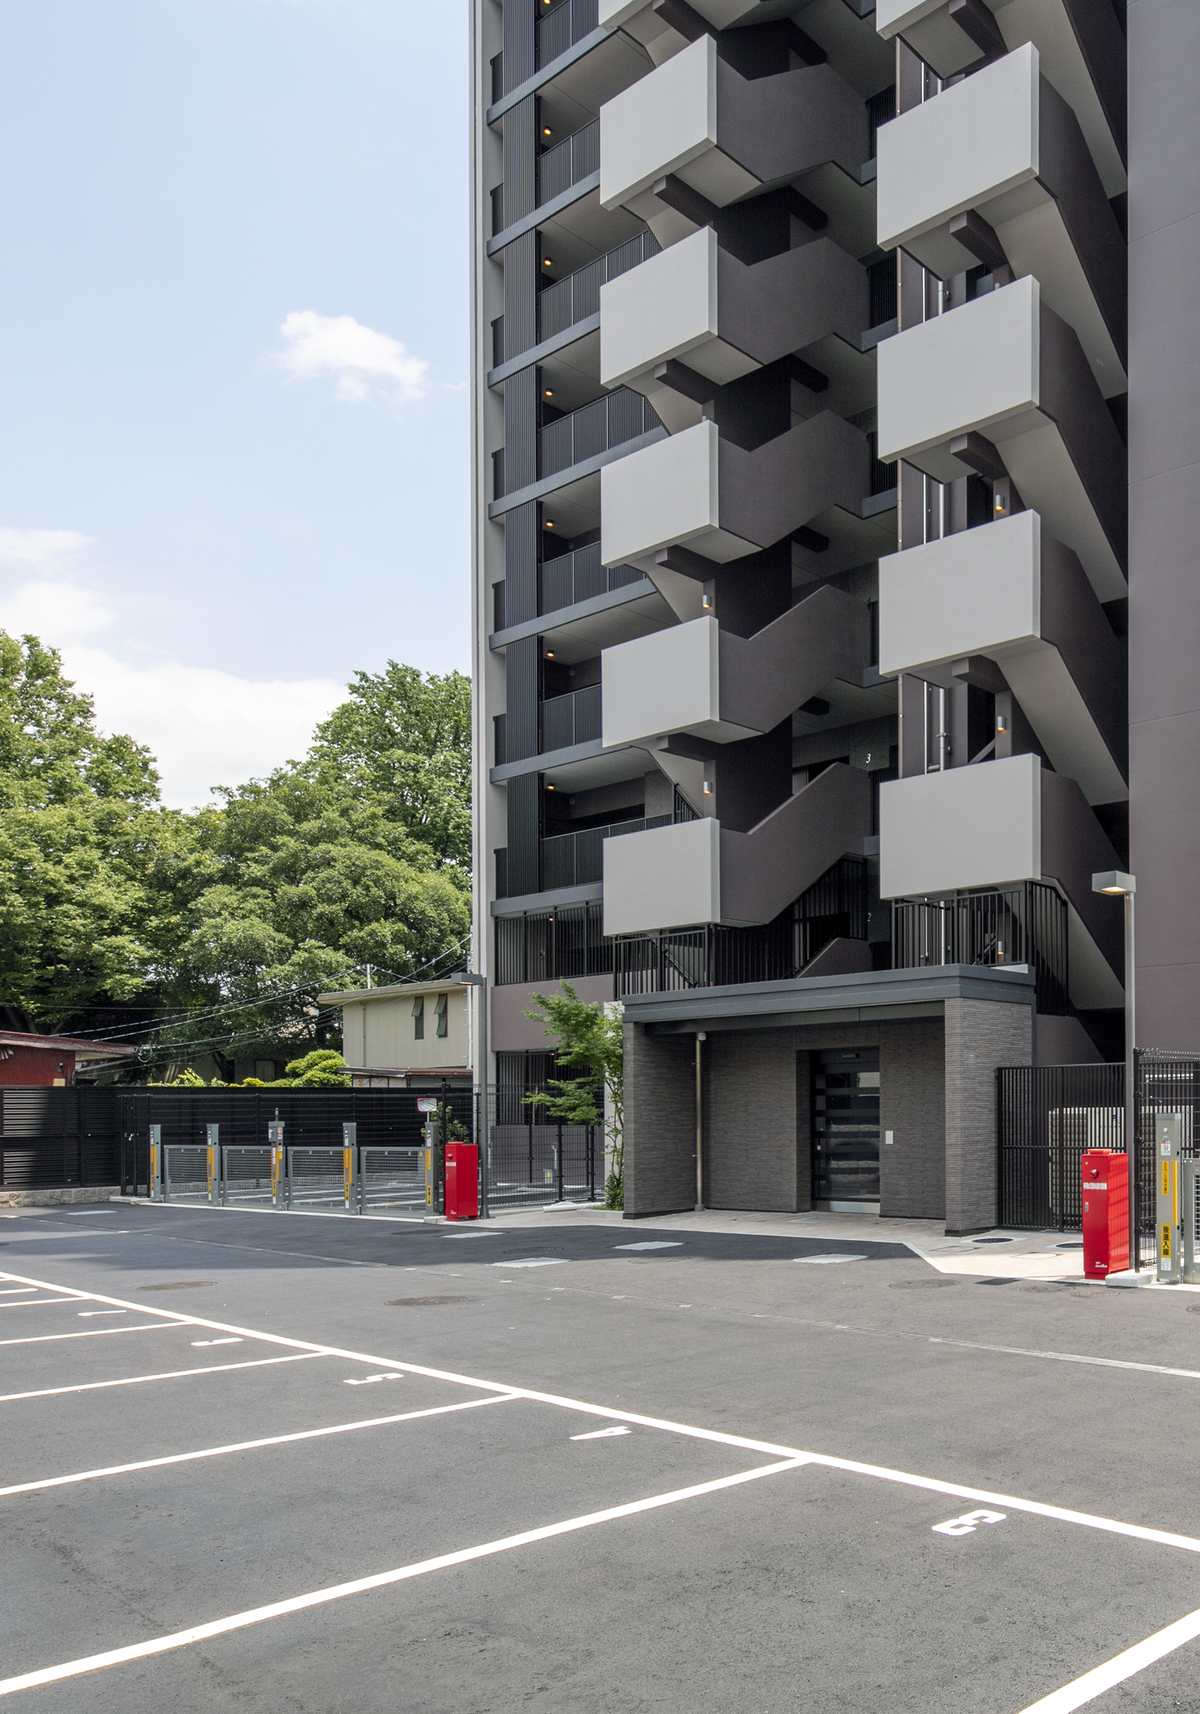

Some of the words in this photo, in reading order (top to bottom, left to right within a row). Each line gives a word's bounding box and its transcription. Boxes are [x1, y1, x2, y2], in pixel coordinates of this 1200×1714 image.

[865, 753, 872, 764] 3
[1162, 1226, 1170, 1256] 後進入庫
[343, 1372, 404, 1386] 5
[569, 1425, 632, 1441] 4
[932, 1509, 1007, 1536] 3
